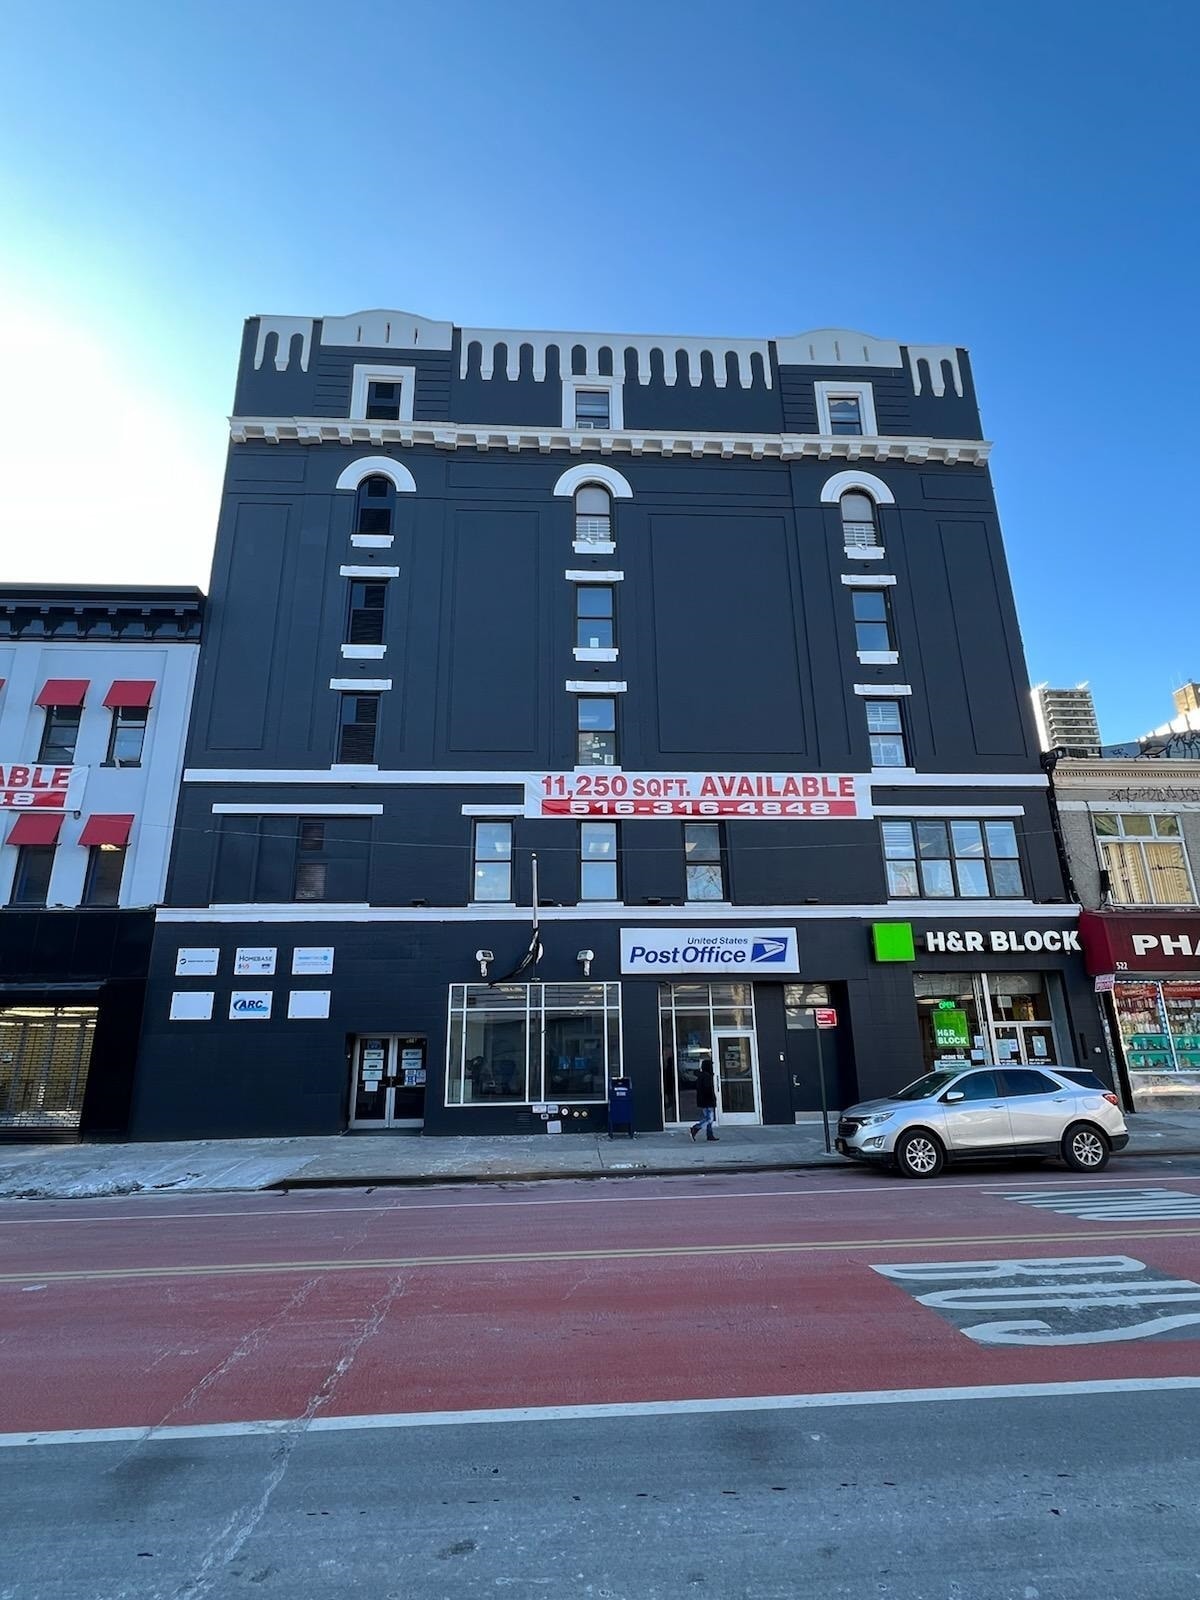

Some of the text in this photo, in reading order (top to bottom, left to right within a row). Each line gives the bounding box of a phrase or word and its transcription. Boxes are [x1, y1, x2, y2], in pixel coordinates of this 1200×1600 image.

[0, 766, 73, 788] BLE
[541, 775, 856, 800] 11,250 SQFT. AVAILABLE
[569, 801, 830, 815] 516-316-4848
[687, 937, 748, 945] United States
[926, 930, 1082, 952] H&R BLOCK
[1132, 934, 1200, 955] PH
[629, 946, 746, 963] Post Office
[1115, 961, 1129, 970] 522
[238, 1000, 264, 1009] ARC
[937, 1029, 955, 1037] H&R
[868, 1255, 1200, 1346] BUS
